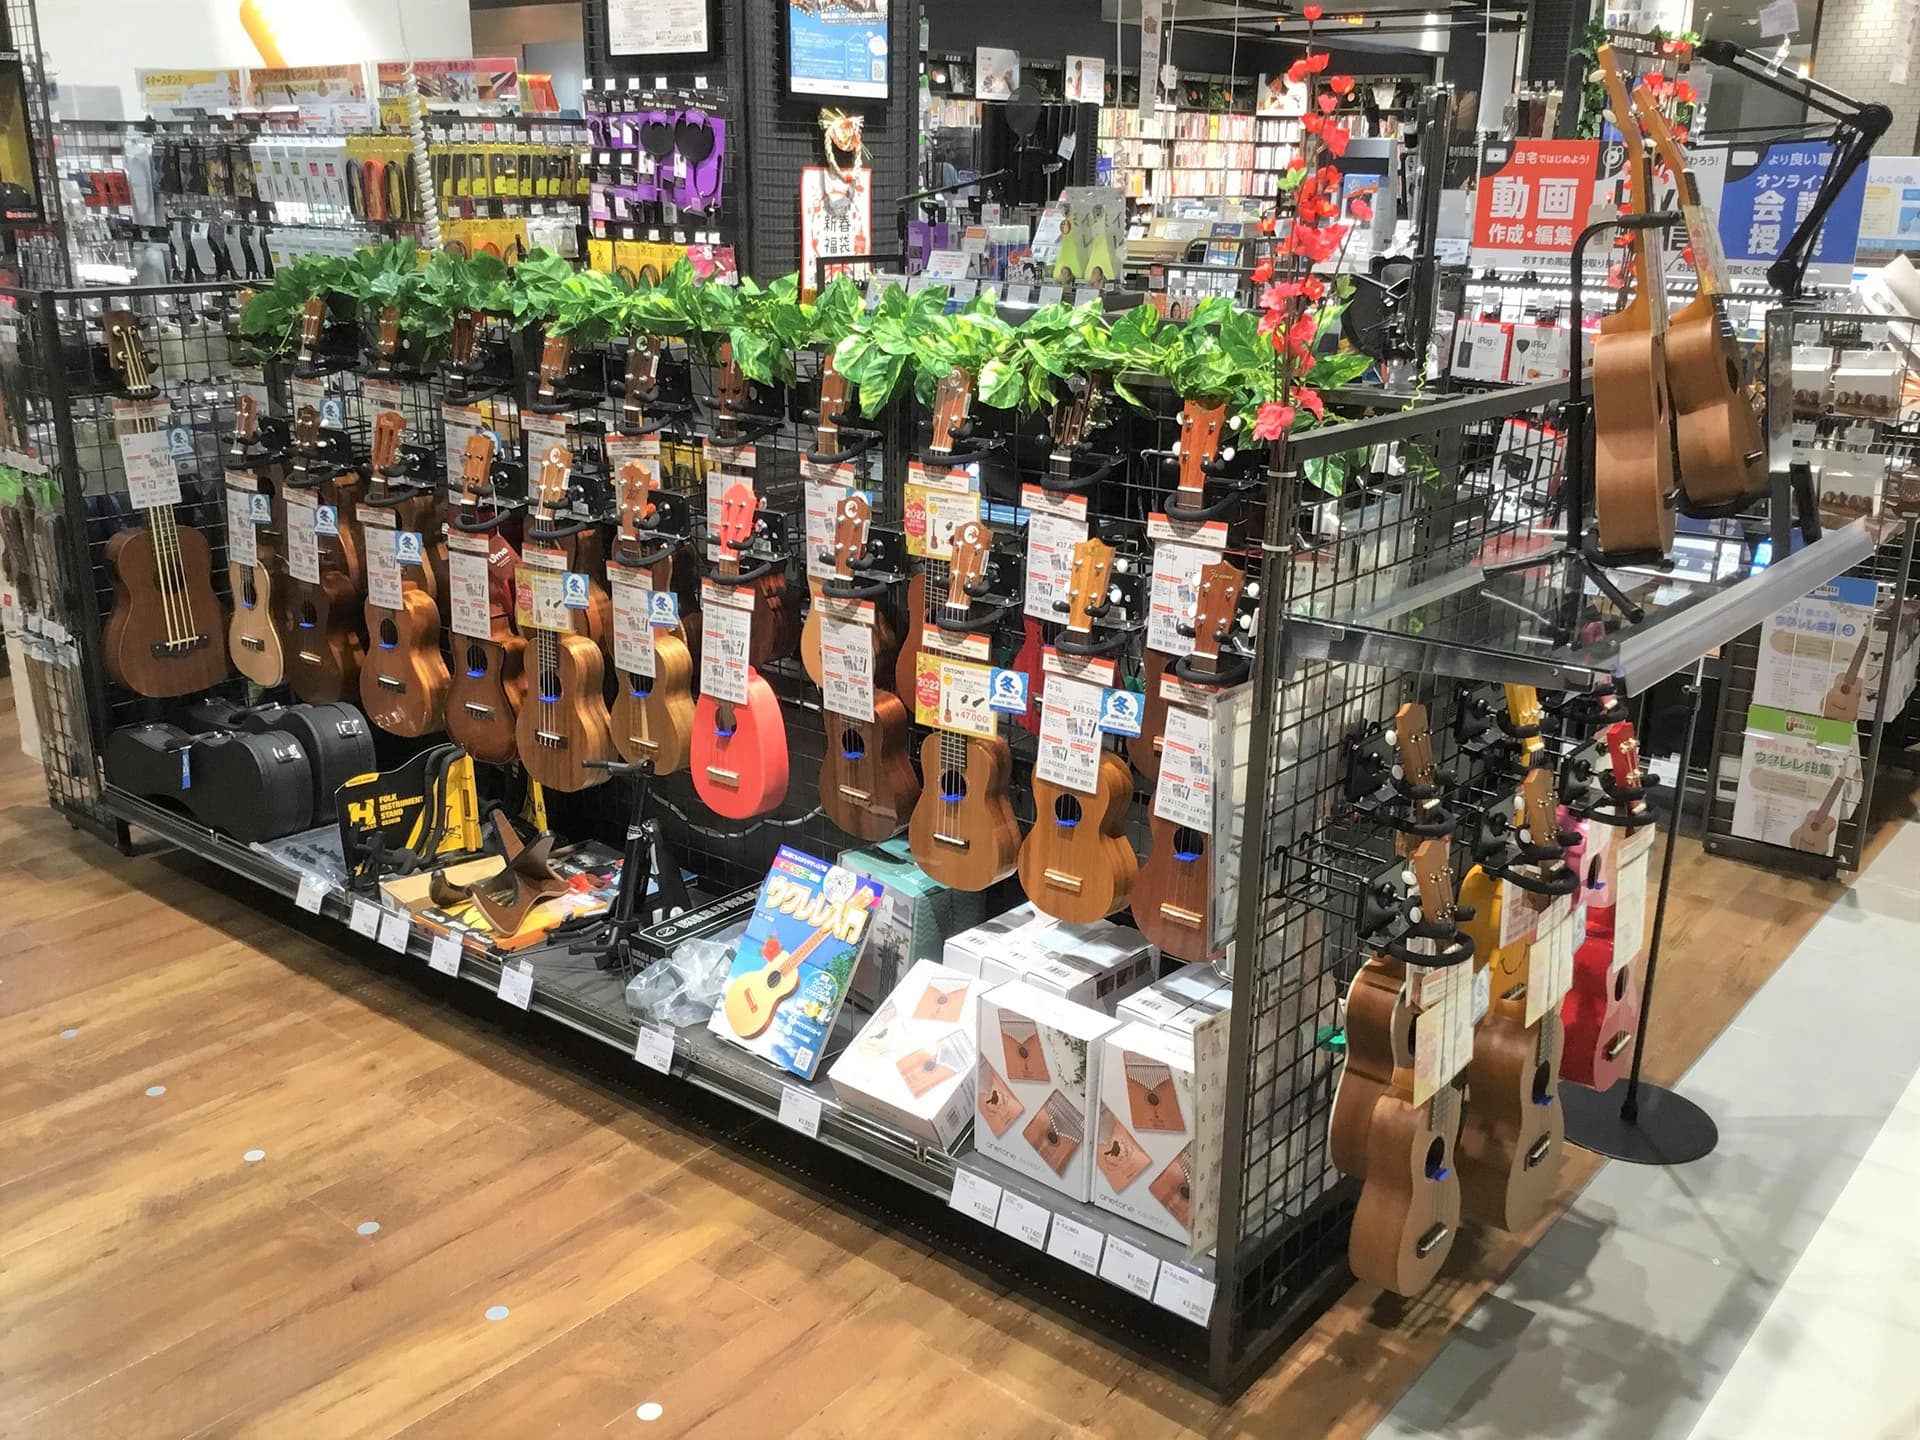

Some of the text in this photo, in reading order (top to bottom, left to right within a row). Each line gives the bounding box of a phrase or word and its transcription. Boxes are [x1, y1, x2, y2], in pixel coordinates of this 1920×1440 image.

[1514, 152, 1590, 165] 自宅ではじめよう!
[1489, 176, 1580, 220] 動画
[824, 215, 851, 232] 新春
[1488, 223, 1573, 246] 作成・編集
[824, 234, 851, 254] 福袋
[905, 509, 926, 519] 2022
[917, 679, 940, 690] 2022
[379, 793, 398, 803] FOLK
[380, 795, 424, 812] INSTRUMENT
[381, 808, 404, 820] STAND
[765, 874, 870, 945] ウクレレ入門
